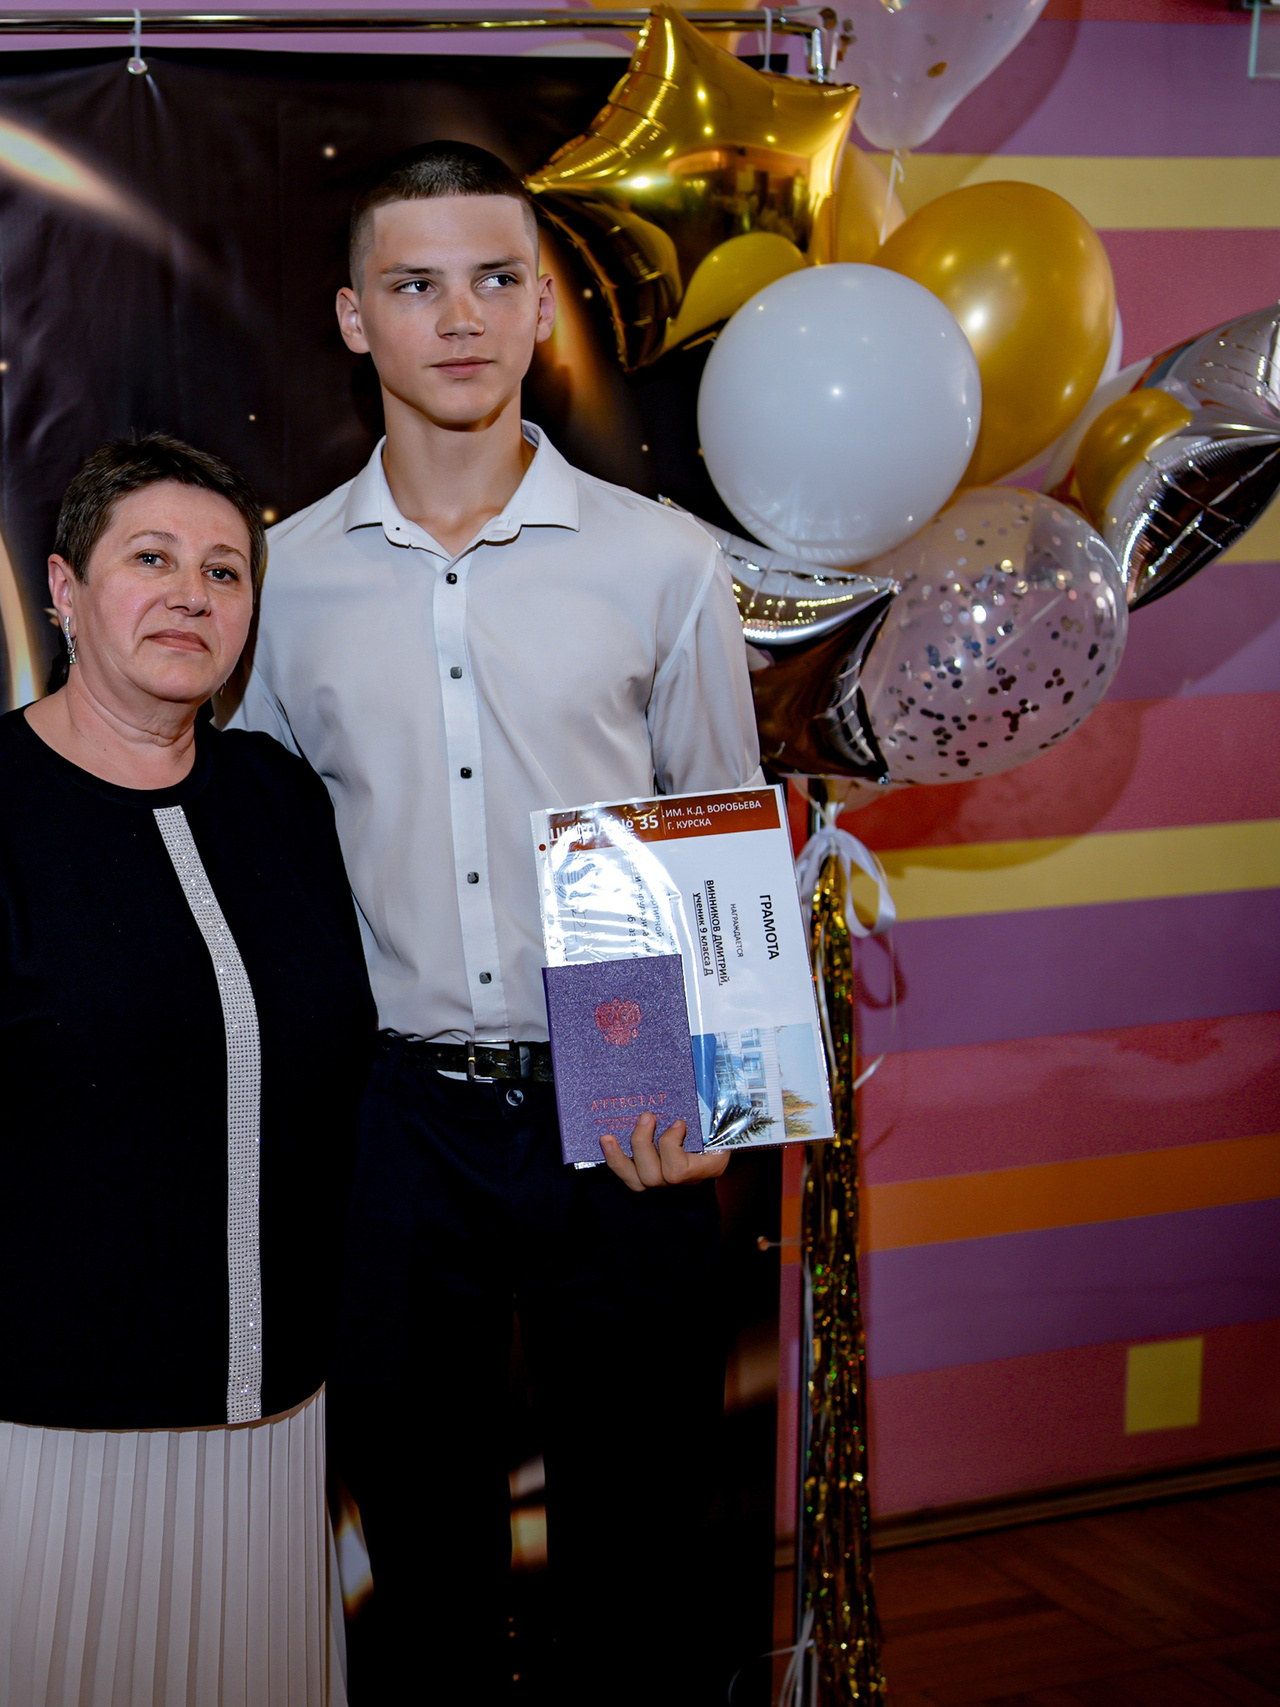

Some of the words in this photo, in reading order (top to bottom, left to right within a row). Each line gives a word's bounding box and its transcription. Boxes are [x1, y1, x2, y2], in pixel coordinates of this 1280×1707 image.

[665, 808, 686, 818] ИМ.
[686, 805, 706, 816] К.Д.
[707, 799, 762, 814] ВОРОБЬЕВА
[639, 814, 659, 831] 35
[667, 821, 675, 831] Г.
[676, 818, 713, 830] КУРСКА
[693, 892, 705, 926] ученик
[705, 879, 721, 933] ВИННИКОВ
[730, 903, 744, 958] НАГРАЖДАЕТСЯ
[759, 894, 780, 960] ГРАМОТА
[701, 935, 711, 966] класса
[704, 968, 714, 976] Д
[591, 1092, 667, 1111] АТТЕСТАТ
